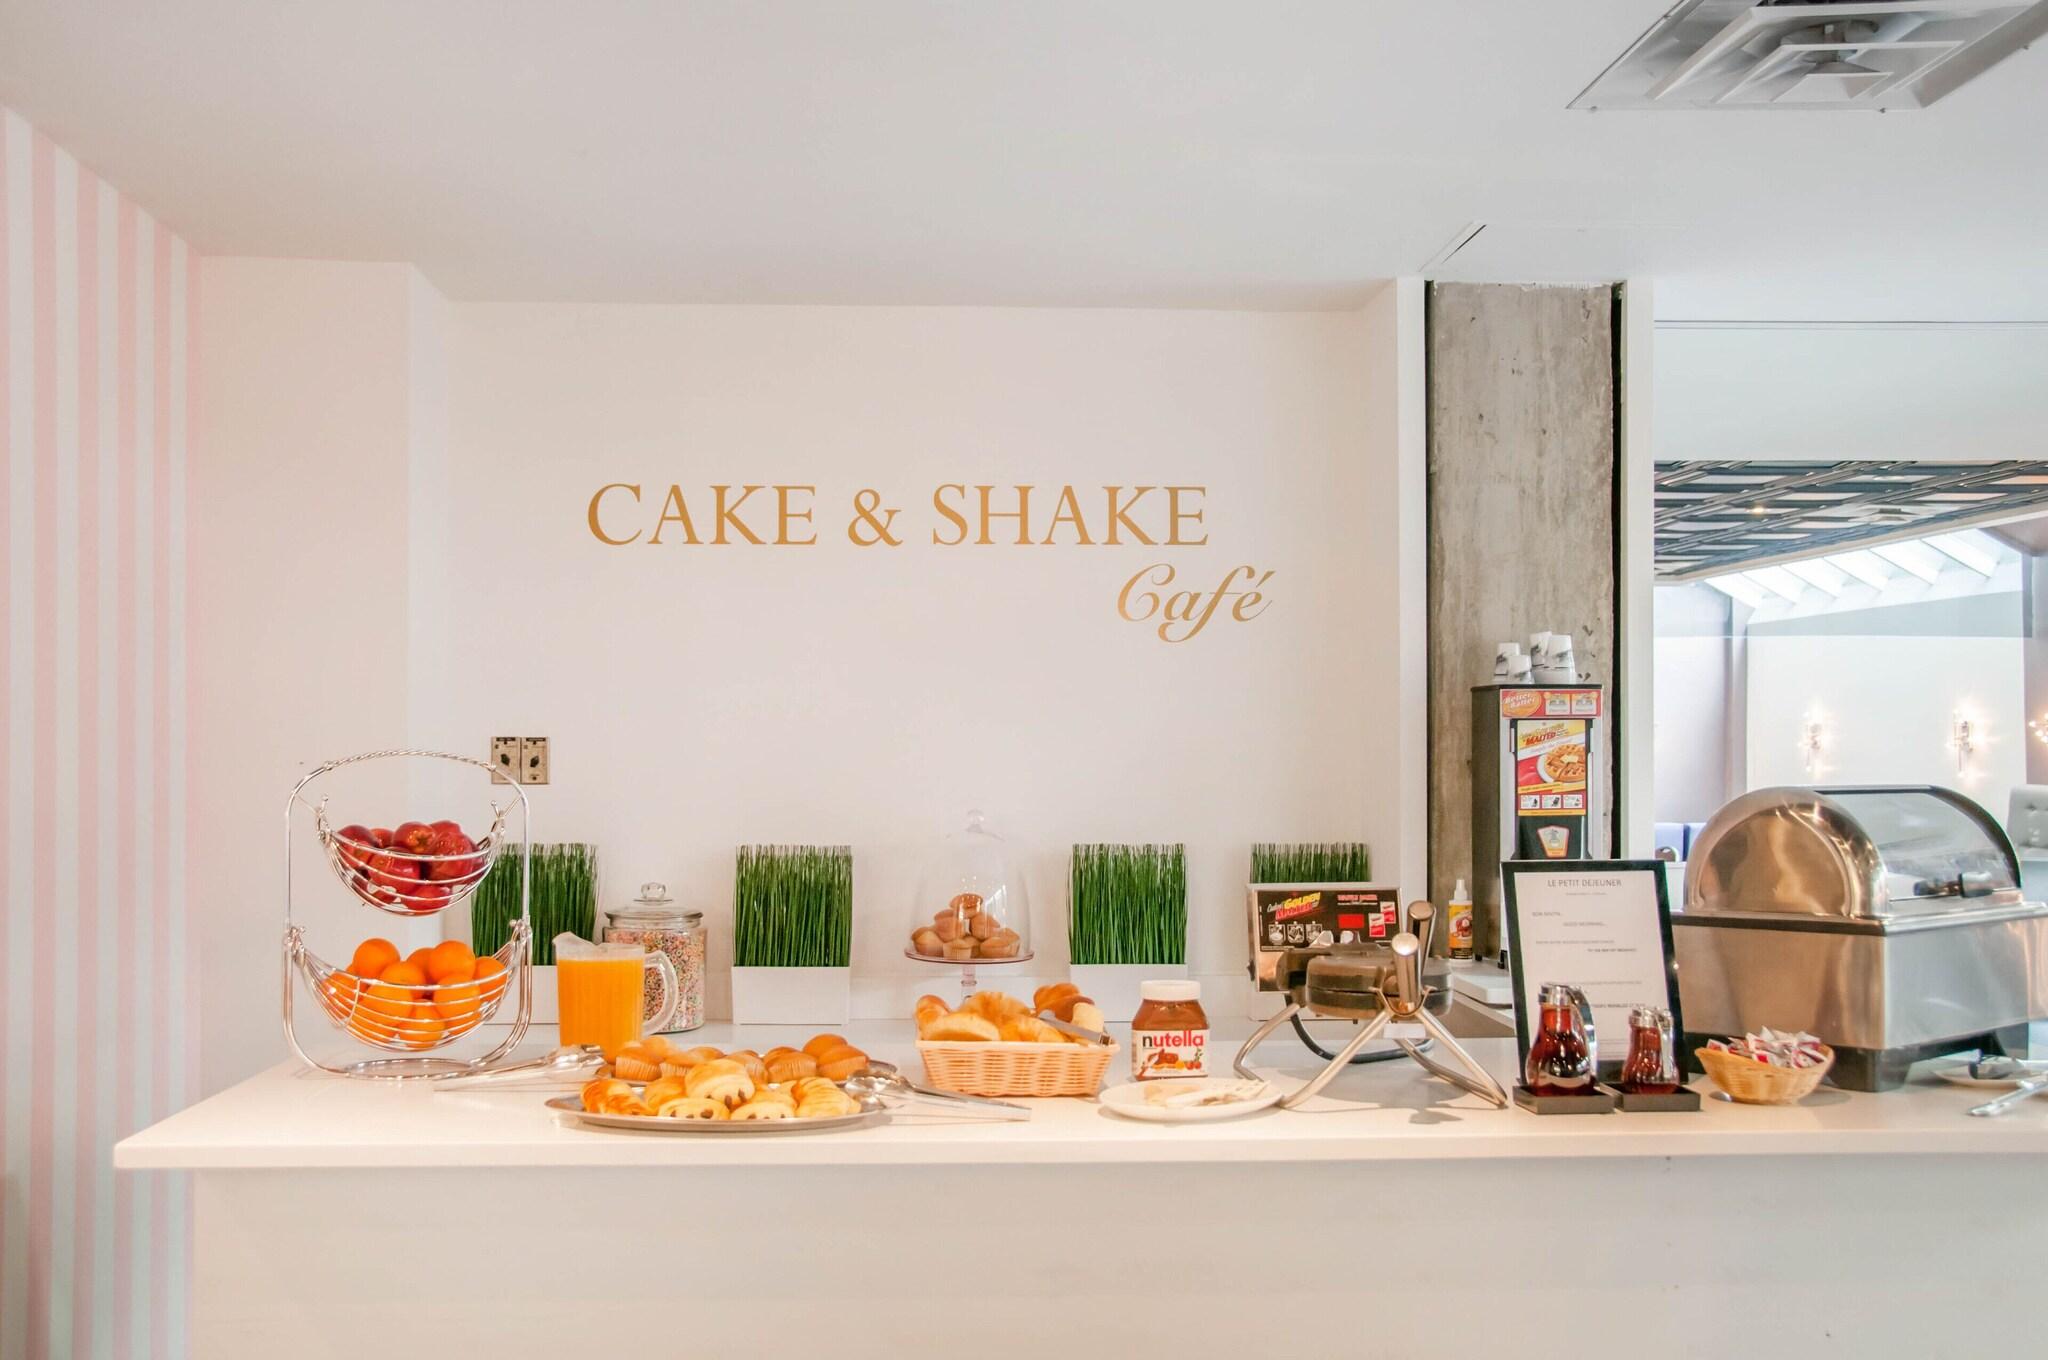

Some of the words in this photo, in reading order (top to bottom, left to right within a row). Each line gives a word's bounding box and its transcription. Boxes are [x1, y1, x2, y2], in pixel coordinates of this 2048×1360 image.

[587, 483, 817, 546] CAKE
[848, 487, 903, 548] &
[932, 484, 1209, 547] SHAKE
[1116, 562, 1275, 643] Café
[1547, 879, 1557, 888] LE
[1558, 879, 1579, 888] PETIT
[1142, 1030, 1204, 1048] nutella
